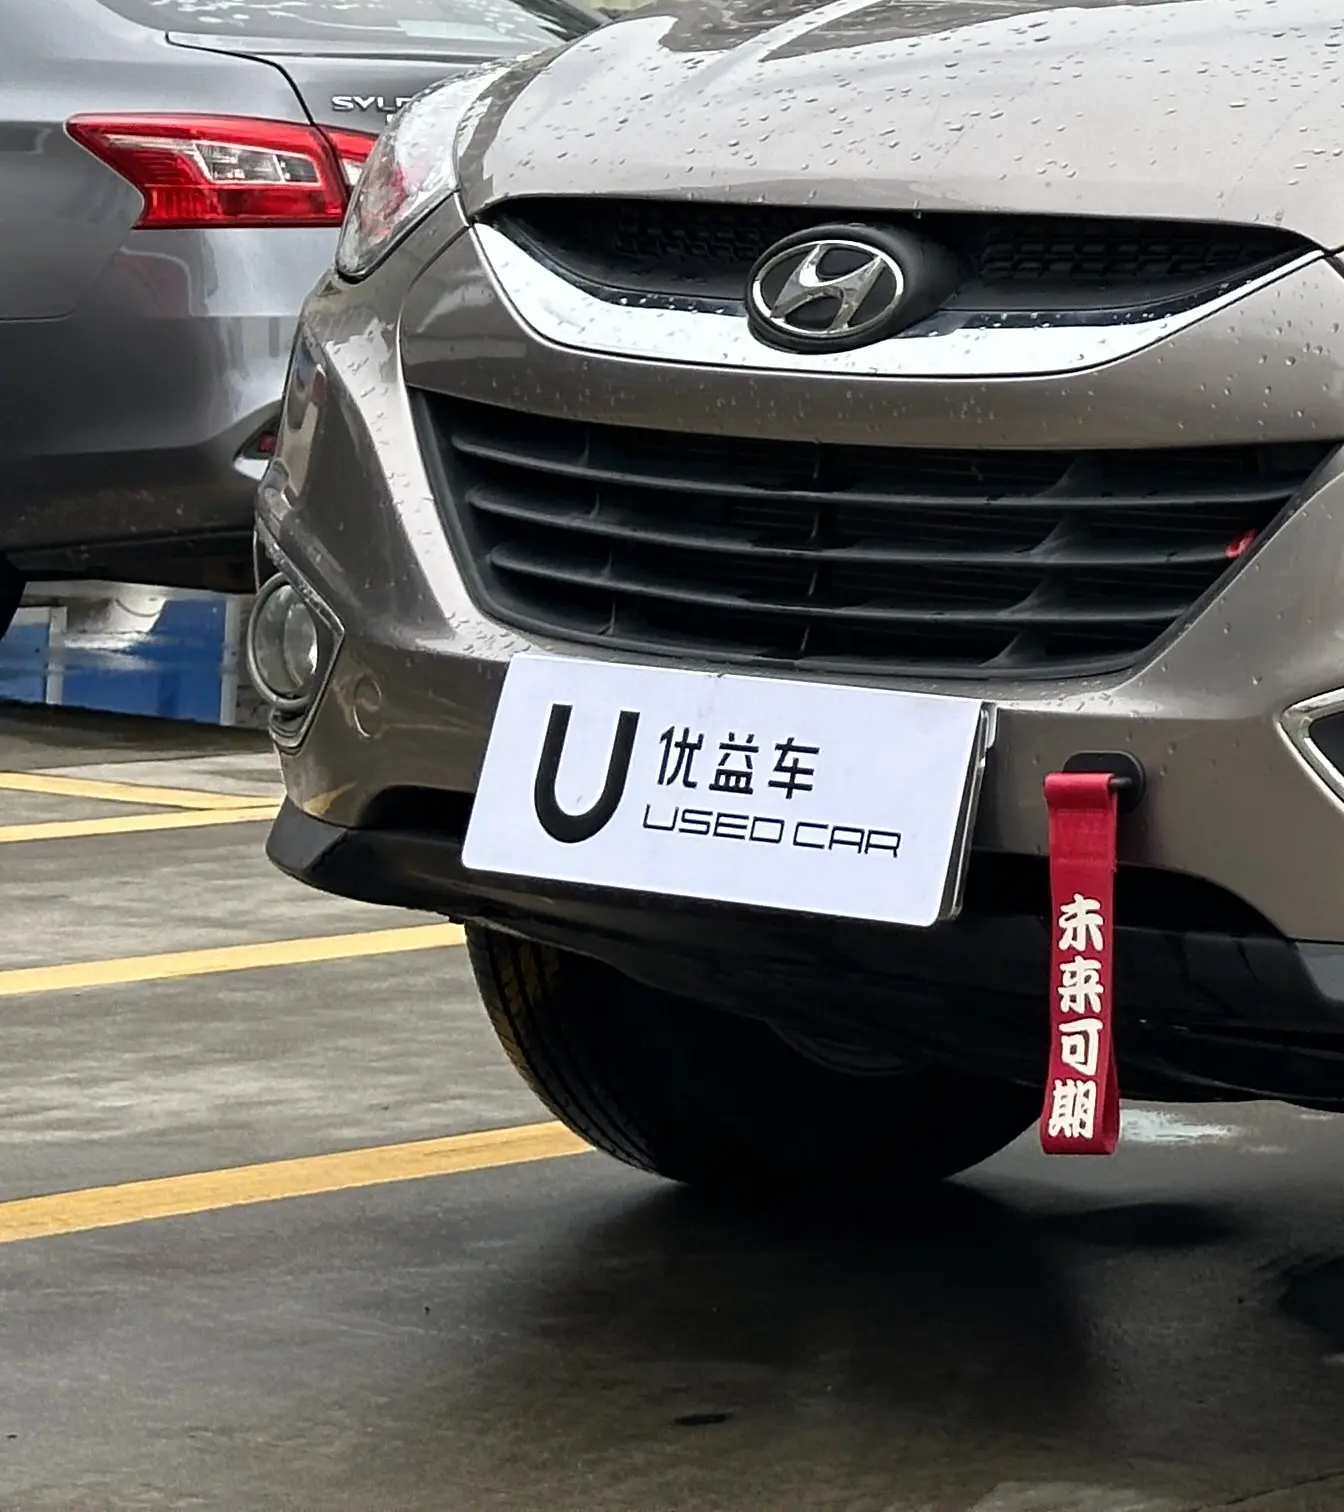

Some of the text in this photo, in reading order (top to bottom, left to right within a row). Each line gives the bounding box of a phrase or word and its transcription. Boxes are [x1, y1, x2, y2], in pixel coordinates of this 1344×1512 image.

[534, 703, 640, 844] U
[658, 725, 821, 800] 优益车
[642, 803, 902, 859] USED CAR
[1047, 893, 1104, 1140] 未来可期
